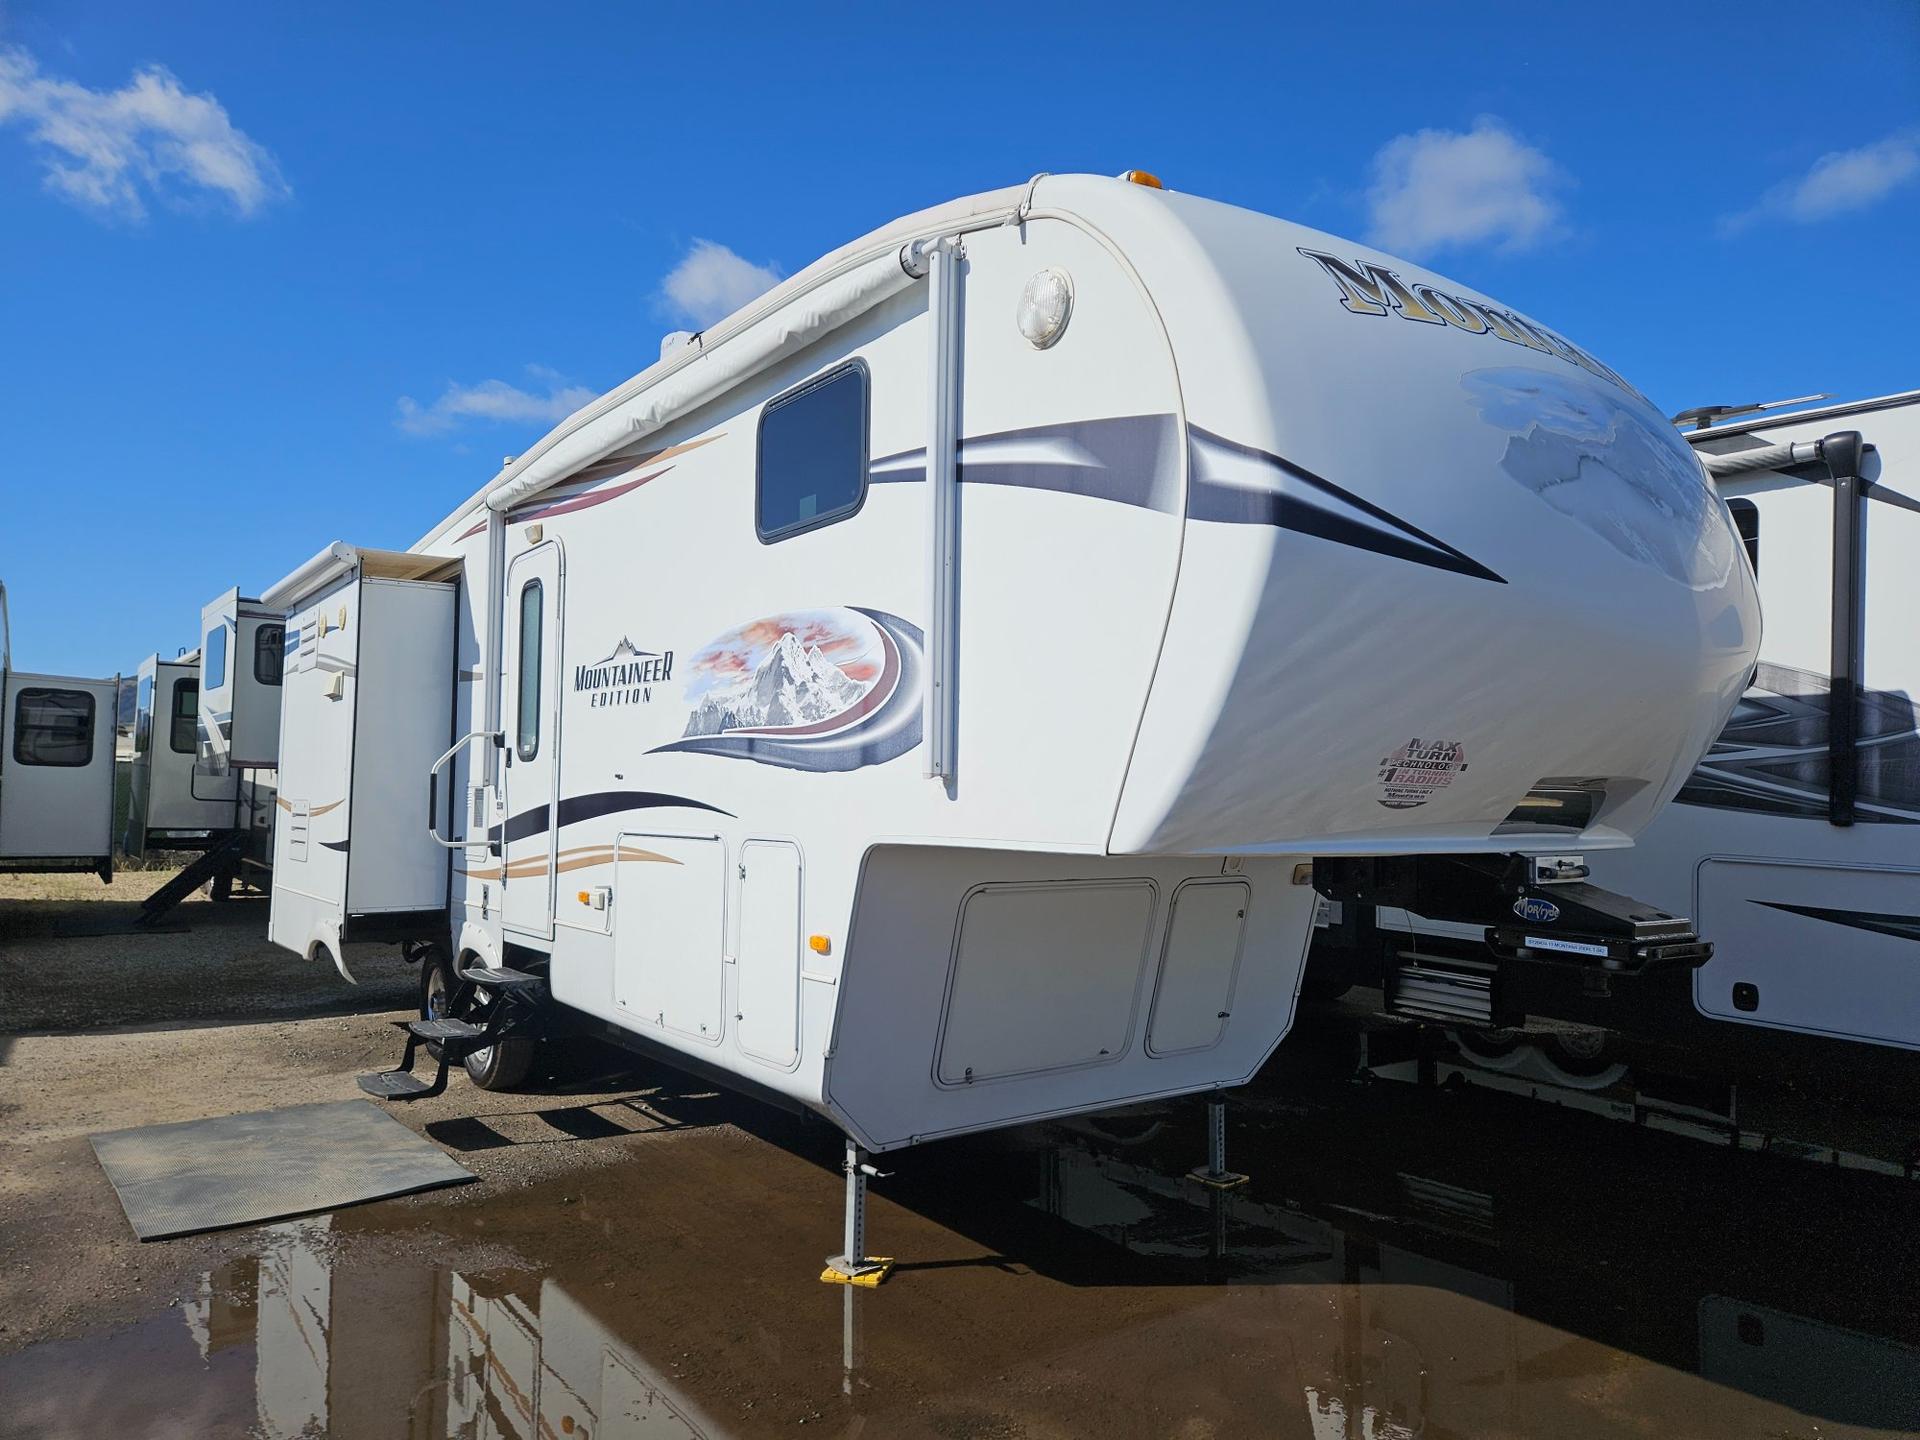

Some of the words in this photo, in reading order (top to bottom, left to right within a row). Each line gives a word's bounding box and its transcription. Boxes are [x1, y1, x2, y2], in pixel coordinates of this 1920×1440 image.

[1296, 246, 1648, 402] Mont
[574, 651, 673, 692] MOUNTAINEER
[591, 687, 651, 707] EDITION
[1408, 738, 1461, 752] MAX
[1407, 749, 1456, 761] TURN
[1390, 759, 1461, 771] TECHNOLOGY
[1393, 774, 1453, 785] RADIUS
[1413, 769, 1456, 777] TURNING
